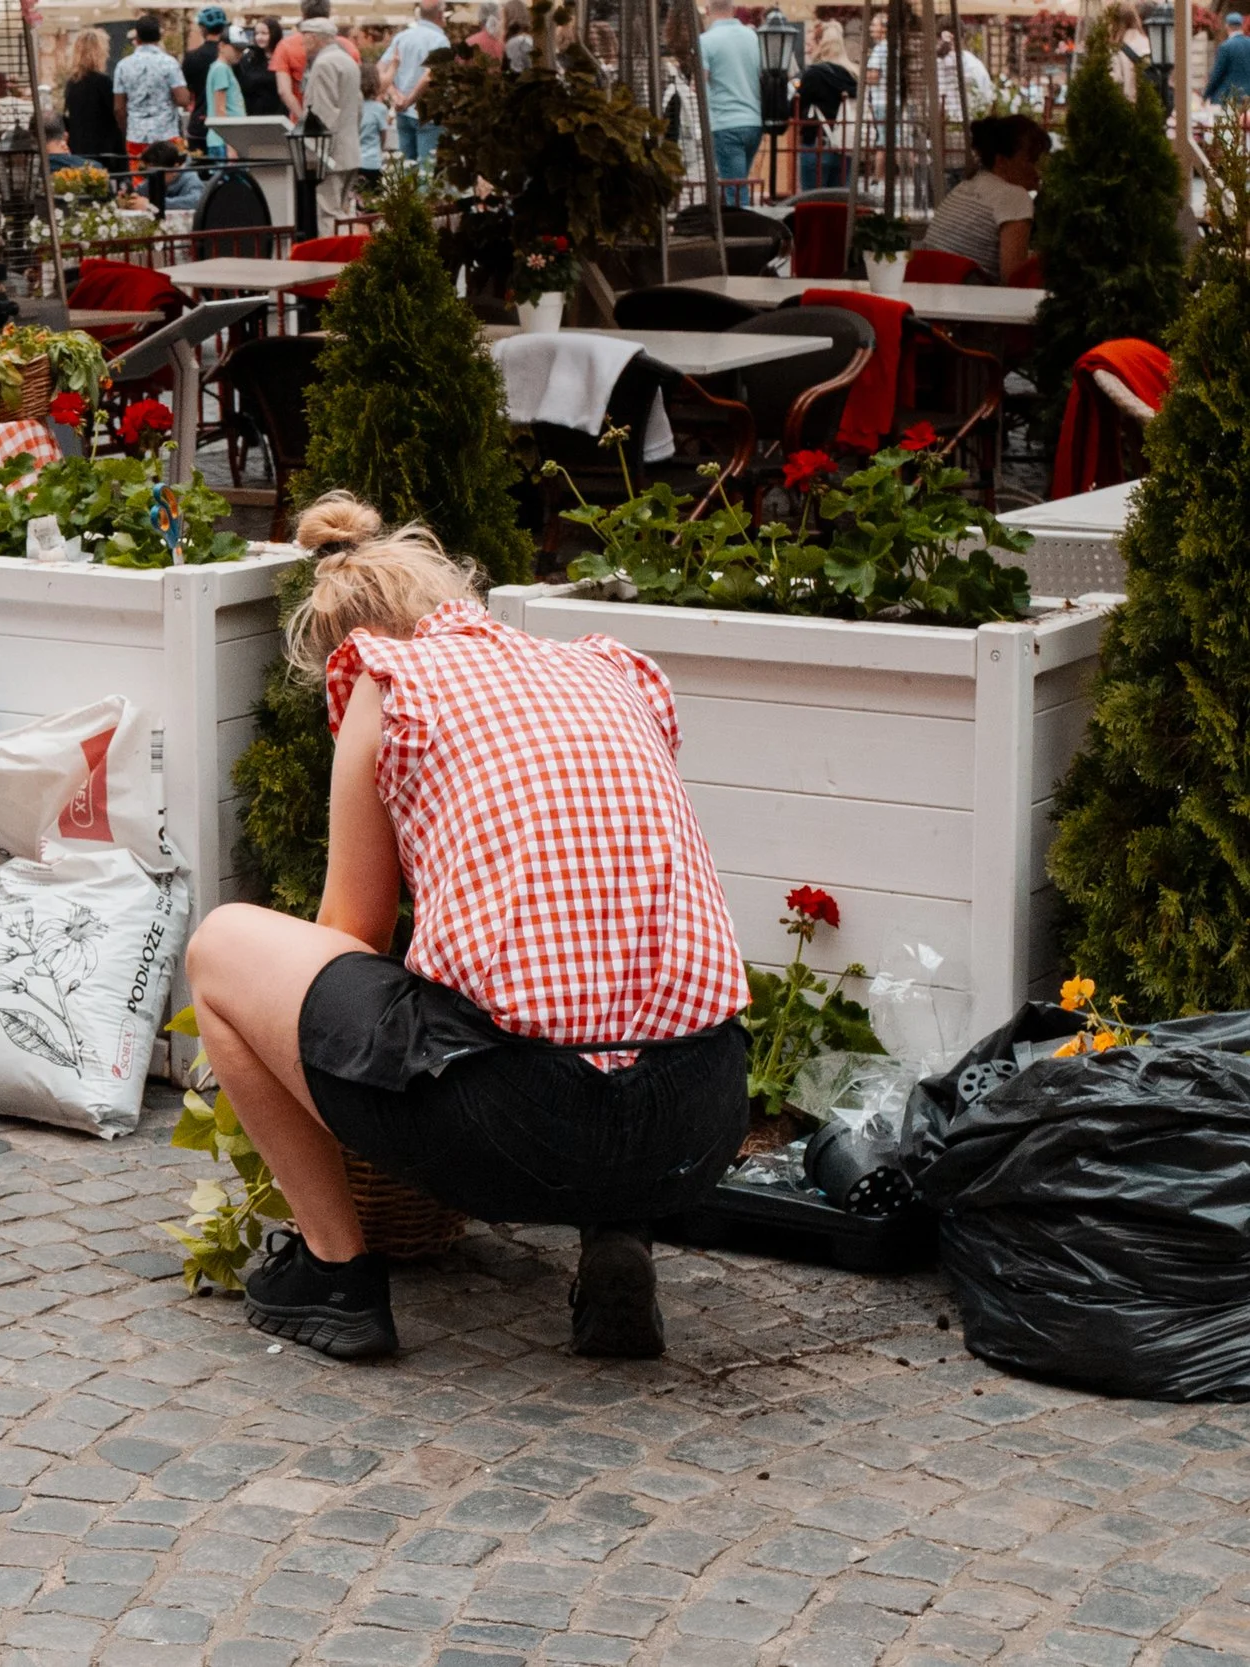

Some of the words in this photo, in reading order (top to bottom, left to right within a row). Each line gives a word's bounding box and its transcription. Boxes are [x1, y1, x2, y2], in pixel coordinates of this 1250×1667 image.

[155, 895, 165, 911] DO
[127, 921, 165, 1014] PODŁOŻE
[120, 1030, 133, 1072] SOBEX
